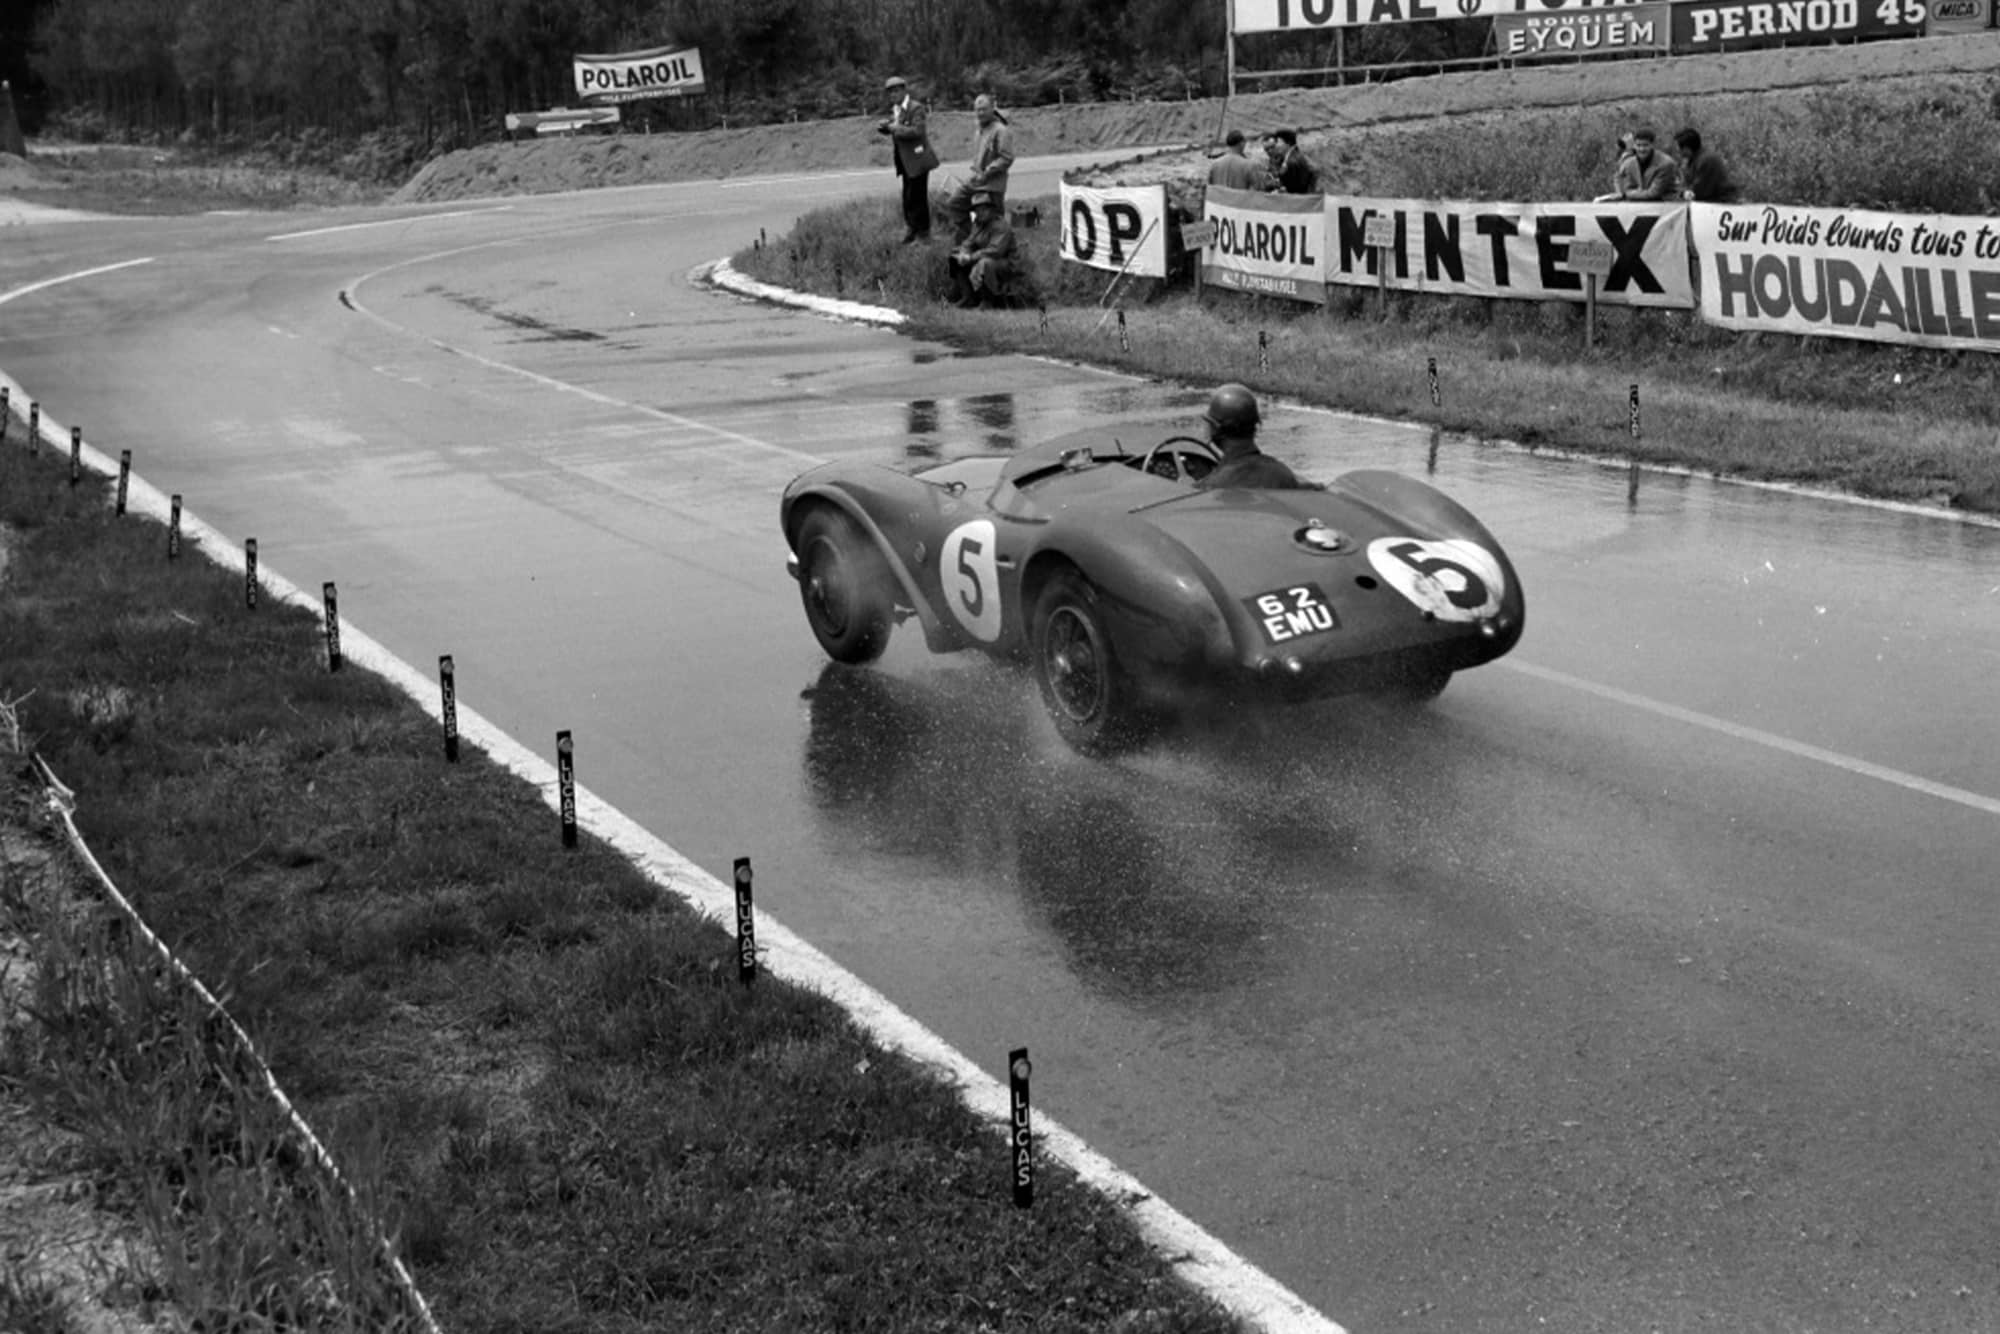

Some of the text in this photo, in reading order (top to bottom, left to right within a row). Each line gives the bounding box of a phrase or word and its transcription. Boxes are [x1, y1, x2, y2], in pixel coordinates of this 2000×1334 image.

[1508, 21, 1653, 51] EYQUEM
[1527, 11, 1634, 27] BOUGIES
[1691, 0, 1926, 42] PERNOD 45
[582, 58, 694, 88] POLAROIL
[1061, 199, 1142, 264] OP
[1338, 206, 1665, 294] MINTEX
[1718, 211, 1756, 241] Sur
[1762, 207, 1821, 246] Poids
[1824, 215, 1904, 253] lourds
[1911, 223, 1967, 257] tous
[1715, 252, 2000, 339] HOUDAILLE
[958, 536, 984, 619] 5
[1386, 541, 1488, 610] 5
[1263, 604, 1334, 642] EMU
[443, 679, 456, 738] LUCAS
[561, 759, 574, 824] LUCAS
[739, 890, 754, 968] LUCAS
[1015, 1091, 1031, 1187] LUCAS
